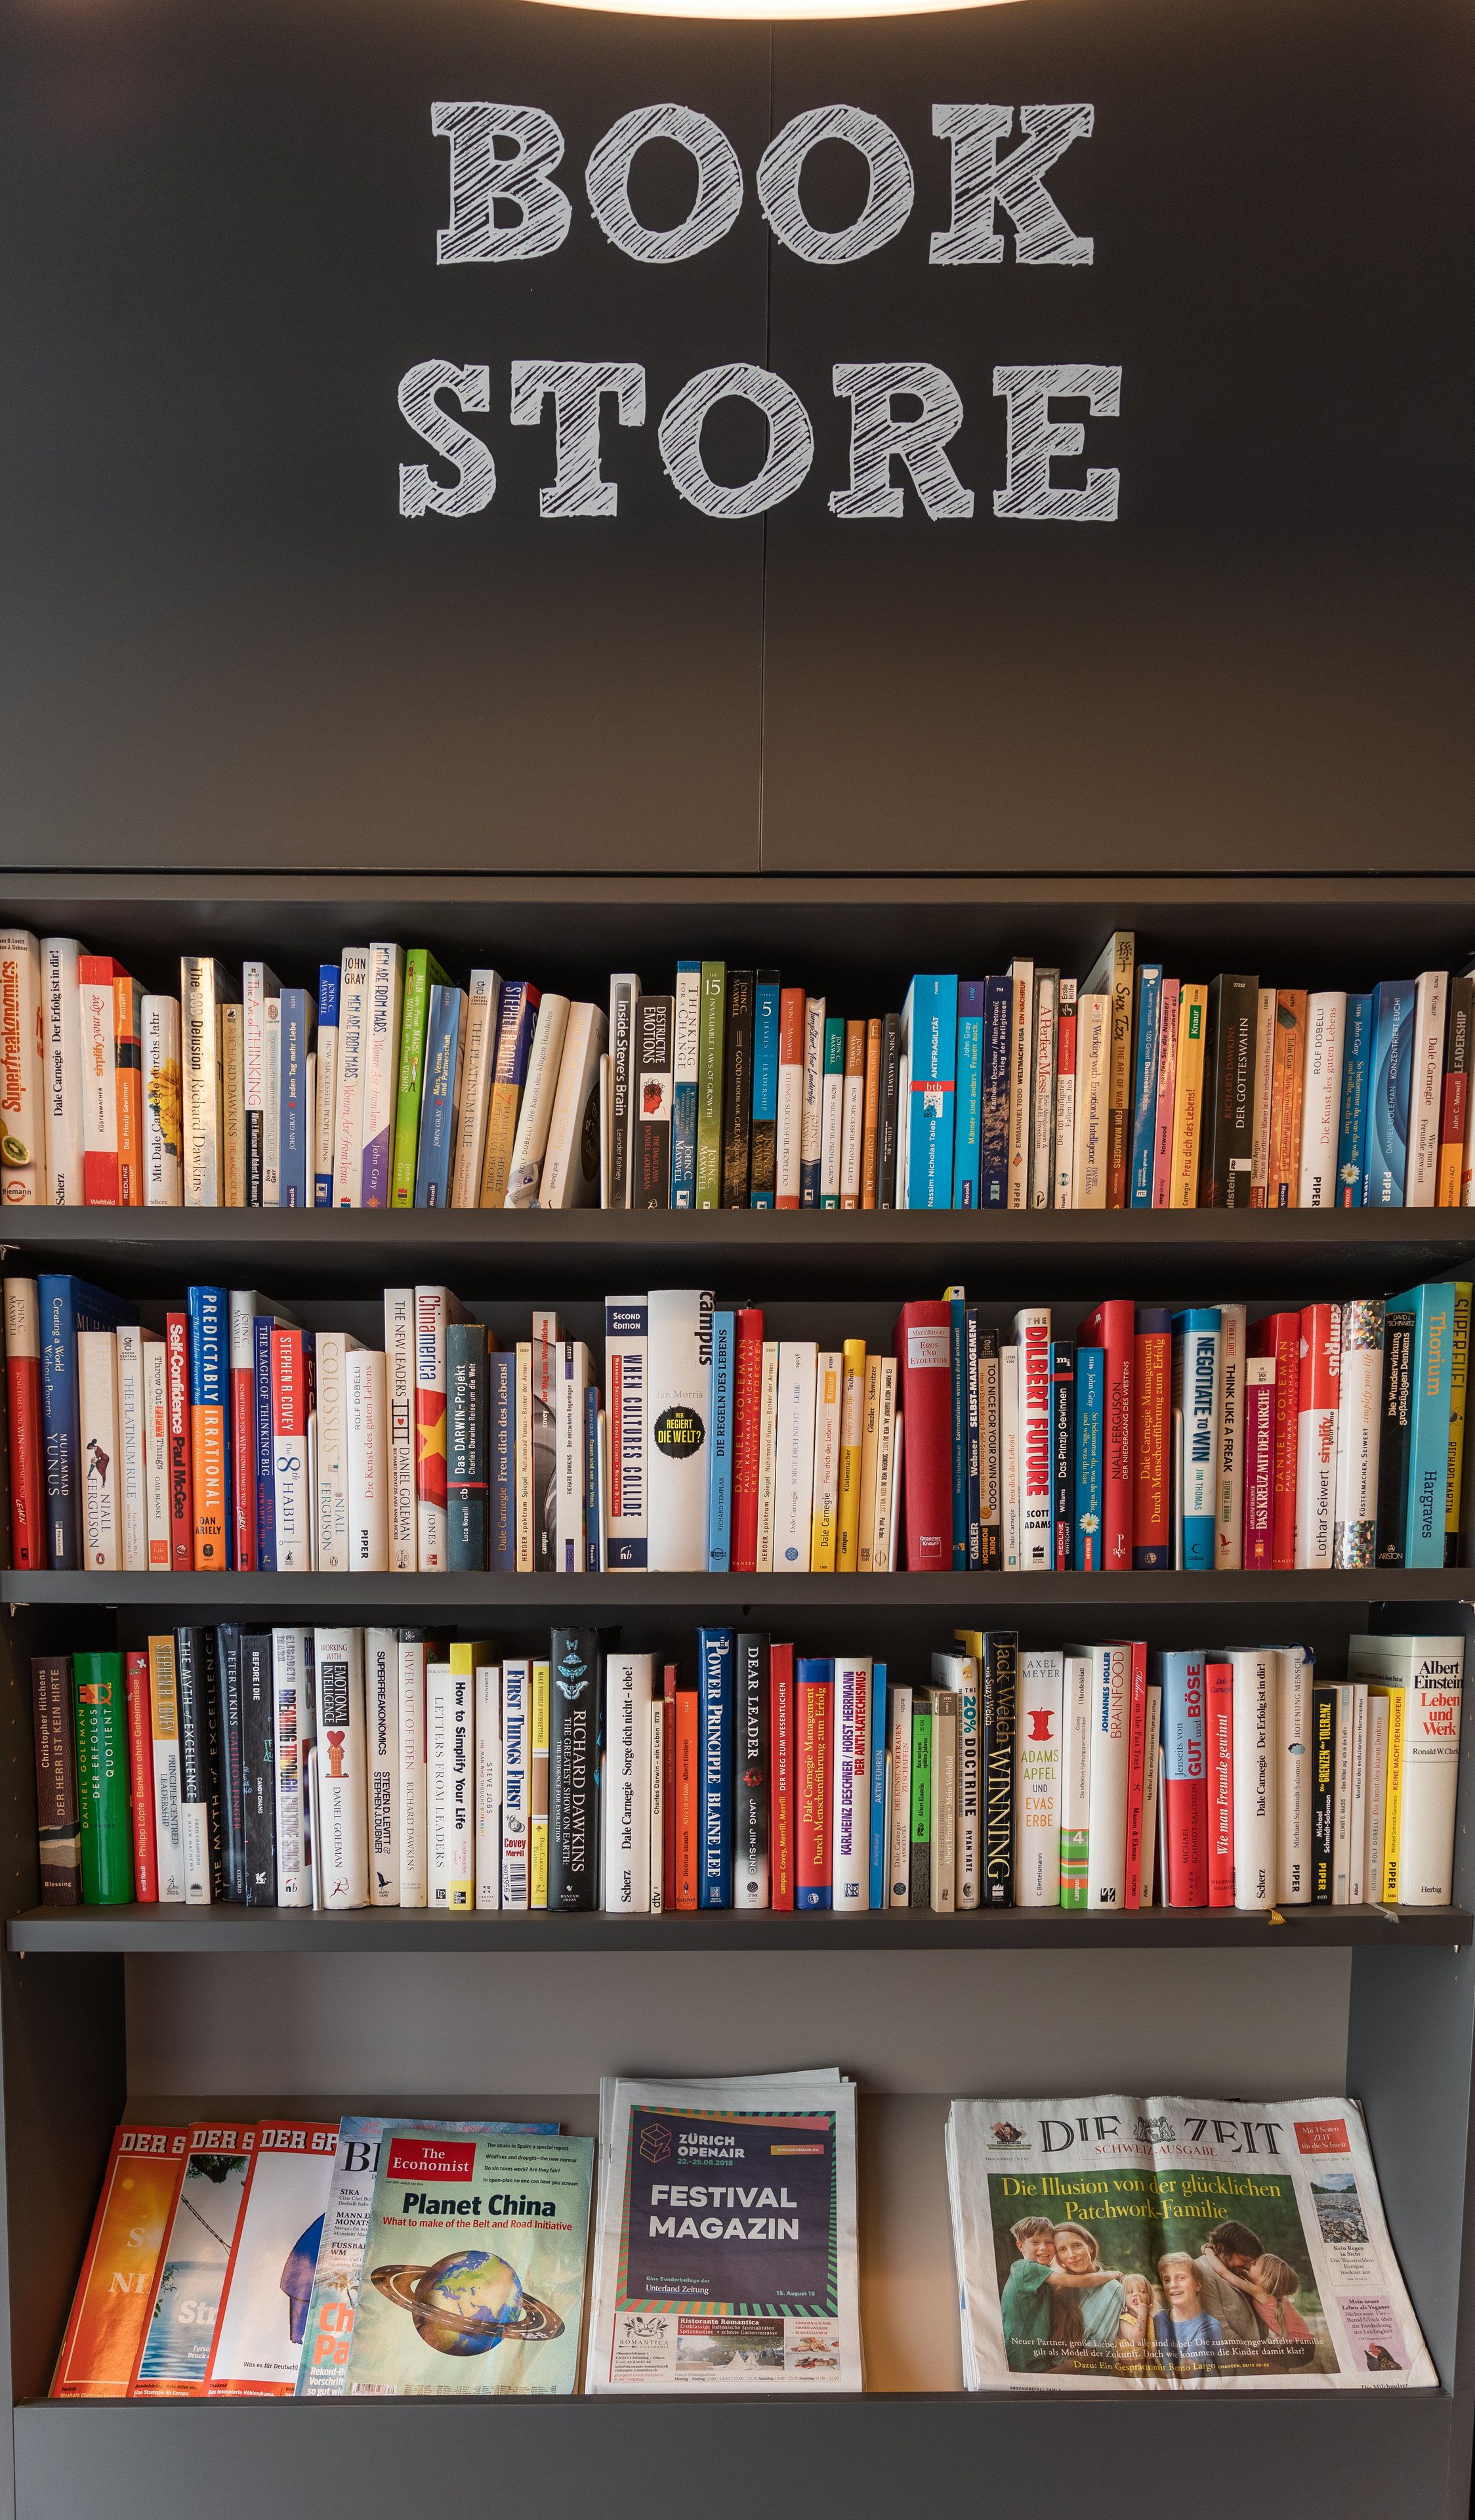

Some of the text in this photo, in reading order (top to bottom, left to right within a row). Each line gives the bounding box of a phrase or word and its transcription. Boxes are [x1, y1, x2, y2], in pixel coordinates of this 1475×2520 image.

[431, 101, 1094, 265] BOOK
[398, 358, 1123, 521] STORE
[344, 957, 366, 971] JOHN
[344, 973, 366, 985] GRAY
[705, 979, 720, 996] 15
[617, 1000, 629, 1037] Inside
[1315, 1009, 1324, 1047] DOBELLI
[1, 961, 26, 1112] Superfreakonomics
[643, 1007, 655, 1064] EMOTIONS
[655, 1007, 666, 1064] DESTRUCTIVE
[1038, 1005, 1052, 1093] A Perfect Mess
[1454, 1010, 1466, 1074] LEADERSHIP
[926, 1082, 942, 1091] btb
[1236, 1017, 1248, 1128] DER GOTTESWAHN
[615, 1085, 627, 1116] Brain
[191, 1078, 207, 1192] Richard Dawkins
[419, 1295, 441, 1381] Chinamerica
[694, 1290, 715, 1366] campus
[1427, 1312, 1446, 1396] Thorium
[280, 1337, 293, 1431] STEPHEN R. COVEY
[203, 1295, 219, 1507] PREDICTABLY IRRATIONAL
[1025, 1326, 1049, 1497] DILBERT FUTURE
[170, 1324, 187, 1519] Self-Confidence Paul McGee
[623, 1354, 642, 1517] WHEN CULTURES COLLIDE
[666, 1419, 693, 1429] REGIERT
[657, 1430, 701, 1443] DIE WELT?
[283, 1482, 295, 1534] HABIT
[1026, 1509, 1050, 1518] SCOTT
[1419, 1471, 1437, 1538] Hargraves
[196, 1525, 222, 1535] ARIELY
[199, 1517, 216, 1525] DAN
[427, 1513, 436, 1545] JONES
[1024, 1521, 1052, 1529] ADAMS
[1022, 1669, 1060, 1678] MEYER
[1413, 1675, 1464, 1689] Einstein
[1419, 1660, 1460, 1675] Albert
[51, 1670, 60, 1702] HIRTE
[323, 1666, 335, 1723] INTELLIGENCE
[334, 1666, 347, 1723] EMOTIONAL
[1110, 1651, 1124, 1738] BRAINFOOD
[1185, 1664, 1201, 1717] BÖSE
[1421, 1692, 1461, 1707] Leben
[377, 1651, 386, 1755] SUPERFREAKONOMICS
[747, 1647, 758, 1759] DEAR LEADER
[1429, 1708, 1453, 1721] und
[52, 1706, 61, 1732] KEIN
[1319, 1703, 1331, 1740] TOLERANZ
[1423, 1722, 1457, 1736] Werk
[41, 1715, 49, 1768] Christopher
[54, 1738, 62, 1755] IST
[1021, 1750, 1059, 1763] ADAMS
[1188, 1738, 1201, 1776] GUT
[1318, 1750, 1330, 1782] GRENZEN
[54, 1760, 64, 1789] HERR
[1023, 1767, 1056, 1780] APFEL
[571, 1710, 587, 1872] RICHARD DAWKINS
[1033, 1784, 1048, 1793] UND
[987, 1746, 1011, 1879] WINNING
[1026, 1797, 1054, 1810] EVAS
[1026, 1814, 1053, 1827] ERBE
[504, 1838, 526, 1849] Covey
[1421, 1885, 1442, 1894] Herbig
[679, 2133, 735, 2146] ZÜRICH
[1038, 2115, 1122, 2152] DIE
[1185, 2117, 1285, 2155] ZEIT
[393, 2157, 469, 2172] Economist
[422, 2148, 445, 2159] The
[678, 2147, 745, 2158] OPENAIR
[1094, 2143, 1218, 2158] SCHWEIZ-AUSGABE
[651, 2185, 797, 2208] FESTIVAL
[1003, 2175, 1281, 2198] Die Illusion von der glücklichen
[402, 2193, 556, 2217] Planet China
[1065, 2198, 1228, 2221] Patchwork-Familie
[383, 2216, 406, 2226] What
[419, 2218, 443, 2227] make
[446, 2218, 455, 2228] of
[456, 2219, 470, 2228] the
[472, 2219, 491, 2228] Belt
[492, 2219, 509, 2229] and
[510, 2219, 532, 2229] Road
[535, 2219, 572, 2231] Initiative
[649, 2216, 799, 2240] MAGAZIN
[646, 2284, 709, 2295] Unterland Zeitung
